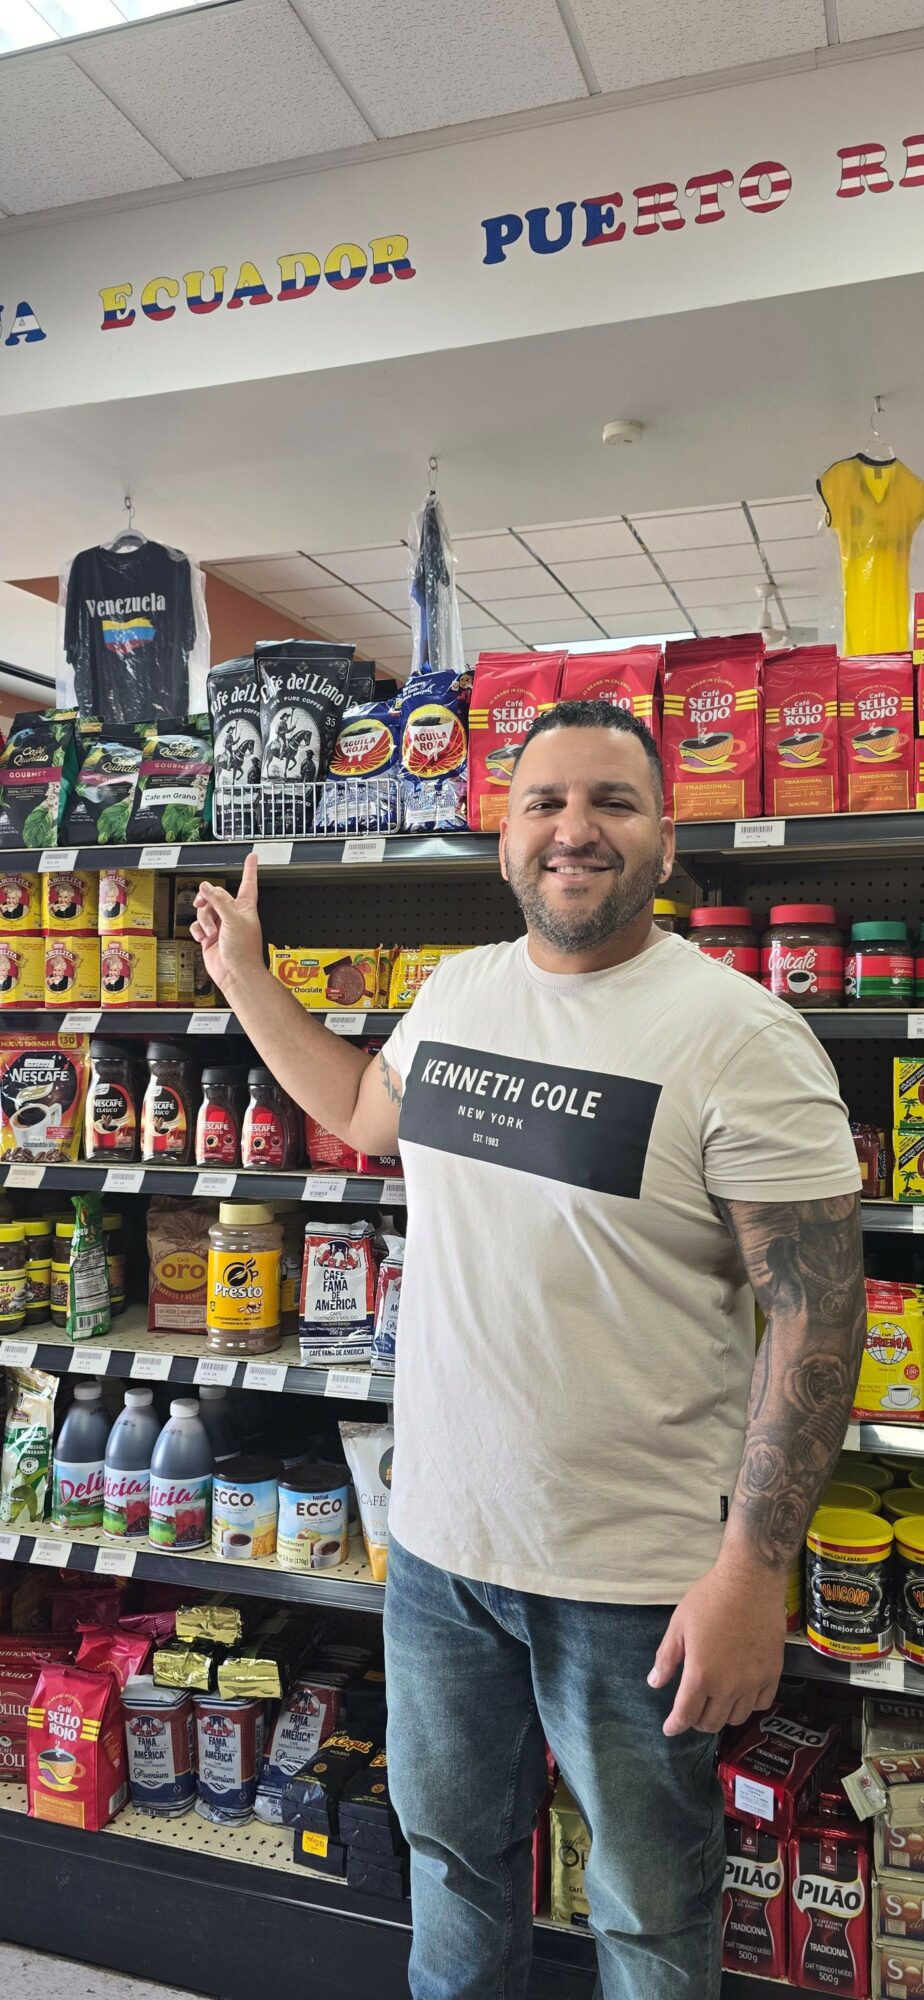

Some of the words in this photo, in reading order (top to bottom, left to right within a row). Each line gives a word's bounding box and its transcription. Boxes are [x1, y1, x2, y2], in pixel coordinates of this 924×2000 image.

[481, 160, 792, 265] PUERTO
[99, 234, 416, 331] ECUADOR
[0, 301, 47, 346] A
[86, 592, 166, 618] Venezuela
[230, 685, 249, 704] del
[286, 672, 309, 690] del
[306, 673, 344, 706] Llano
[599, 691, 618, 699] Café
[701, 689, 720, 698] Café
[869, 691, 885, 699] Café
[301, 697, 324, 712] COFFEE
[688, 693, 733, 710] SELLO
[794, 699, 810, 707] Café
[858, 696, 899, 711] SELLO
[243, 707, 260, 718] COFFE
[492, 705, 536, 721] SELLO
[690, 706, 731, 723] ROJO
[783, 704, 823, 716] SELLO
[860, 706, 898, 721] ROJO
[495, 720, 534, 734] ROJO
[785, 714, 822, 726] ROJO
[343, 736, 376, 748] AGUILA
[413, 731, 448, 742] AGUILA
[345, 744, 369, 753] ROJA
[155, 762, 195, 770] GOURMET
[9, 770, 47, 779] GOURMET
[684, 783, 732, 791] TRADICIONAL
[173, 792, 197, 801] Grano
[48, 876, 82, 886] ABUELITA
[102, 875, 126, 885] UELITA
[0, 949, 17, 959] ELITA
[278, 958, 321, 986] Cruz
[59, 1036, 76, 1044] 130
[421, 1058, 525, 1103] KENNETH
[530, 1081, 602, 1119] COLE
[457, 1104, 485, 1121] NEW
[490, 1112, 524, 1130] YORK
[472, 1132, 484, 1144] EST.
[485, 1135, 499, 1148] 1983
[161, 1263, 206, 1280] oro
[0, 1285, 16, 1293] sto
[214, 1282, 263, 1298] Presto
[323, 1279, 349, 1292] FAMA
[331, 1291, 340, 1299] DE
[314, 1298, 357, 1311] AMERICA
[864, 1334, 913, 1351] CREMA
[309, 1349, 321, 1357] CAFÉ
[342, 1348, 365, 1356] AMERICA
[60, 1469, 103, 1507] Deli
[104, 1477, 150, 1497] licia
[151, 1485, 199, 1507] licia
[214, 1488, 254, 1507] ECCO
[360, 1493, 387, 1507] CAFÉ
[296, 1498, 343, 1517] ECCO
[820, 1583, 870, 1607] YAUCONO
[822, 1619, 829, 1627] El
[830, 1623, 853, 1634] mejor
[829, 1641, 841, 1649] CAFÉ
[57, 1704, 72, 1714] Café
[47, 1710, 81, 1729] SELLO
[289, 1713, 309, 1725] FAMA
[48, 1722, 78, 1741] ROJO
[137, 1736, 157, 1746] FAMA
[208, 1736, 227, 1747] FAMA
[329, 1749, 350, 1757] MOLIDO
[756, 1748, 790, 1765] TRADICIONAL
[133, 1767, 169, 1779] Premium
[203, 1767, 236, 1784] Premium
[725, 1862, 781, 1890] PILÃO
[797, 1880, 861, 1910] PILÃO
[730, 1921, 768, 1937] TRADICIONAL
[809, 1942, 849, 1959] TRADICIONAL
